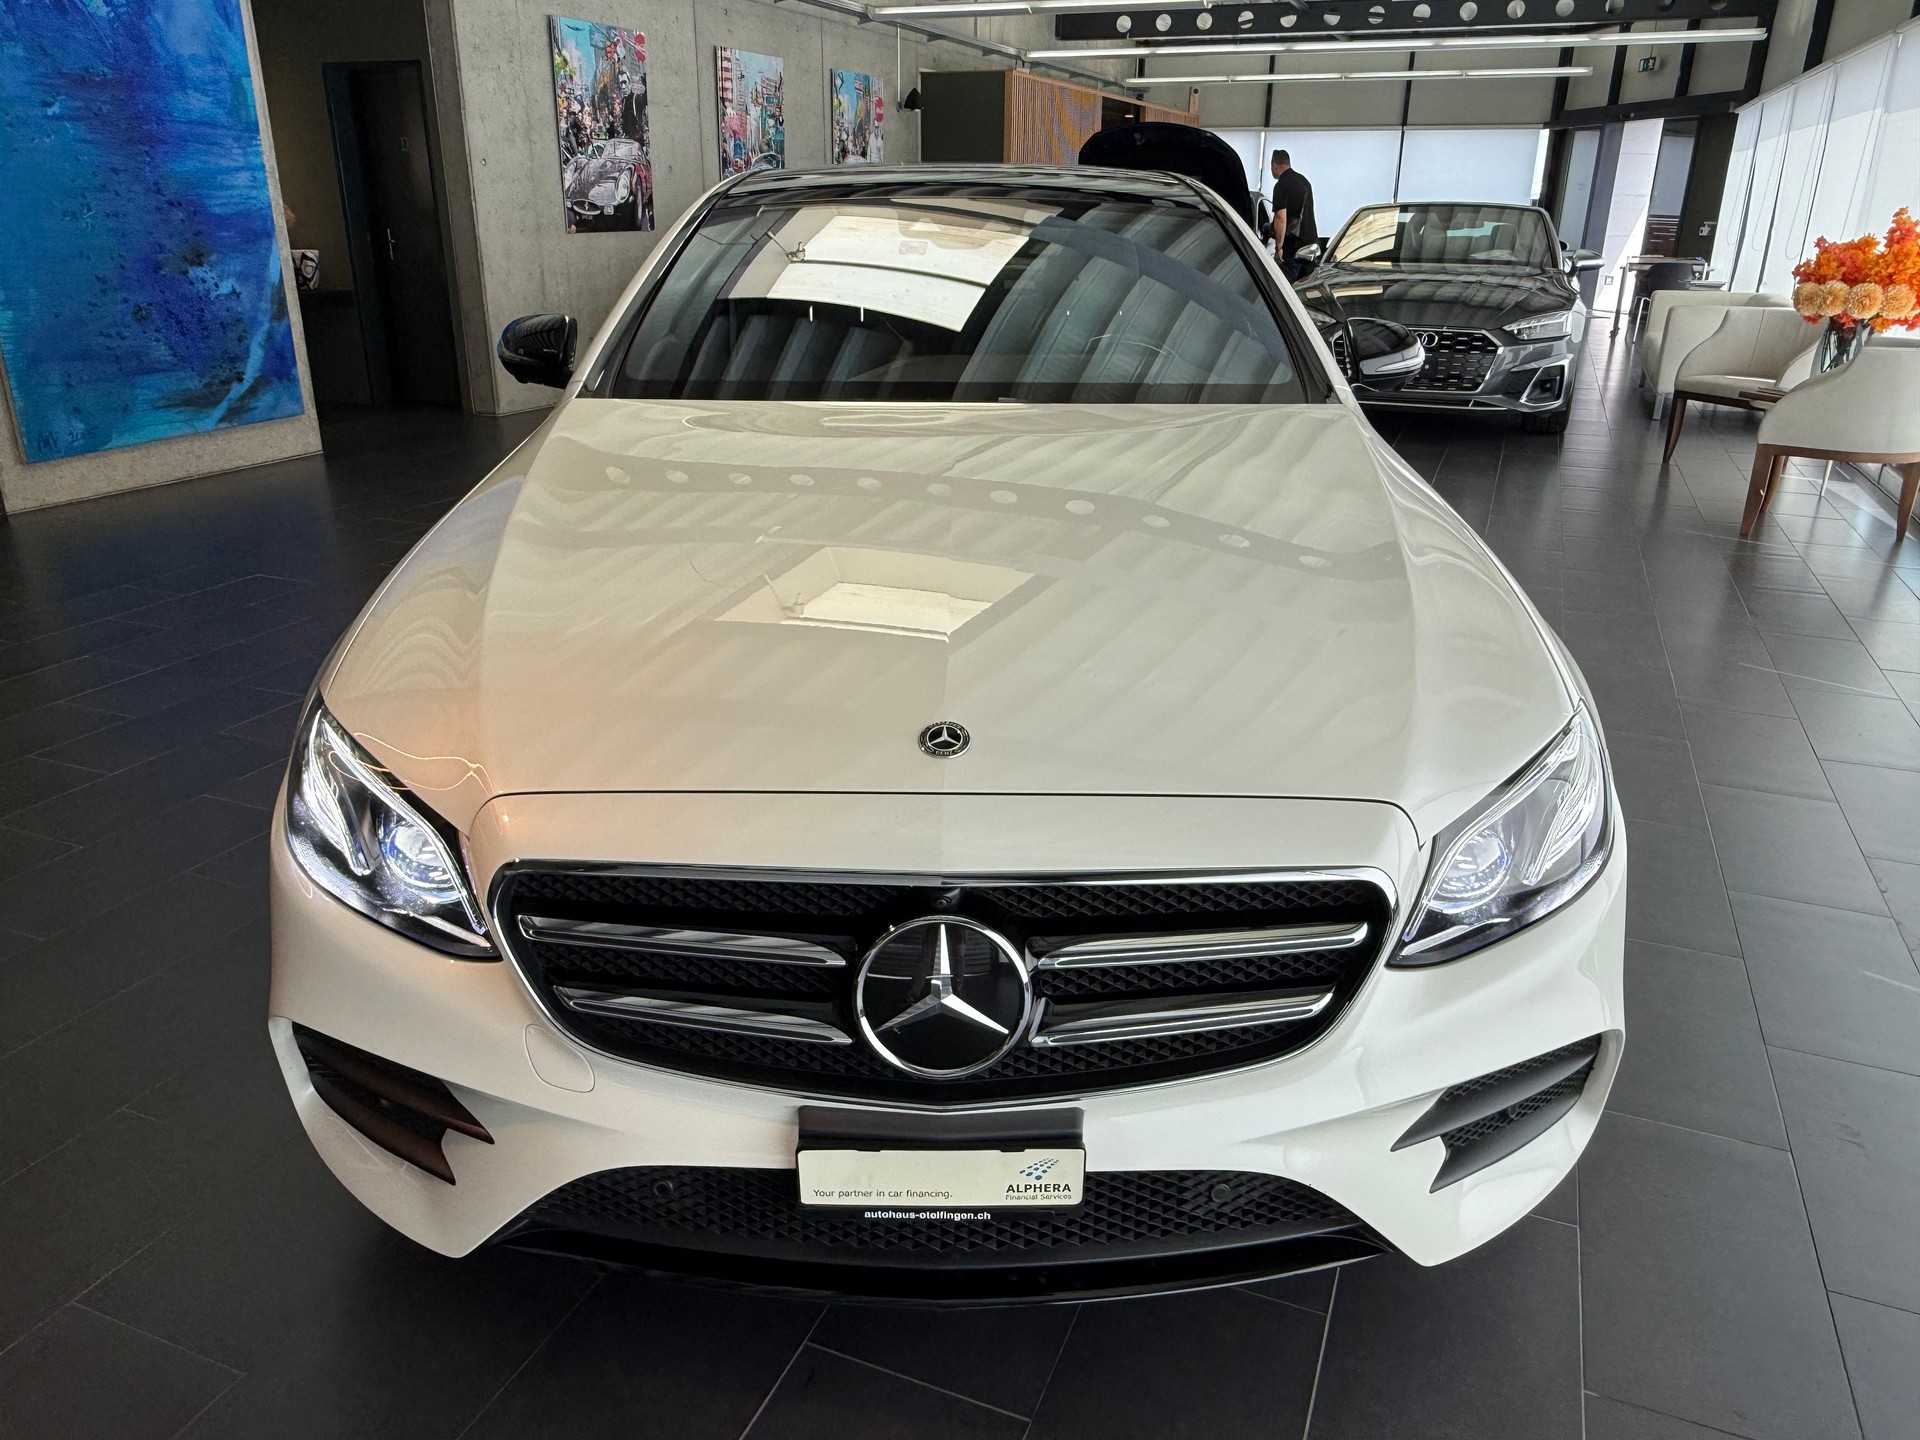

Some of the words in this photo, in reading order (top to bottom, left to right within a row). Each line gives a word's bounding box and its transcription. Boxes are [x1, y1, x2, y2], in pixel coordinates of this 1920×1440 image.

[1006, 1183, 1072, 1193] ALPHERA
[813, 1189, 835, 1197] Your
[838, 1189, 873, 1199] partner
[876, 1189, 885, 1197] in
[888, 1190, 903, 1198] car
[906, 1189, 953, 1200] financing.
[864, 1210, 991, 1221] autohaus-otelfingen.ch
